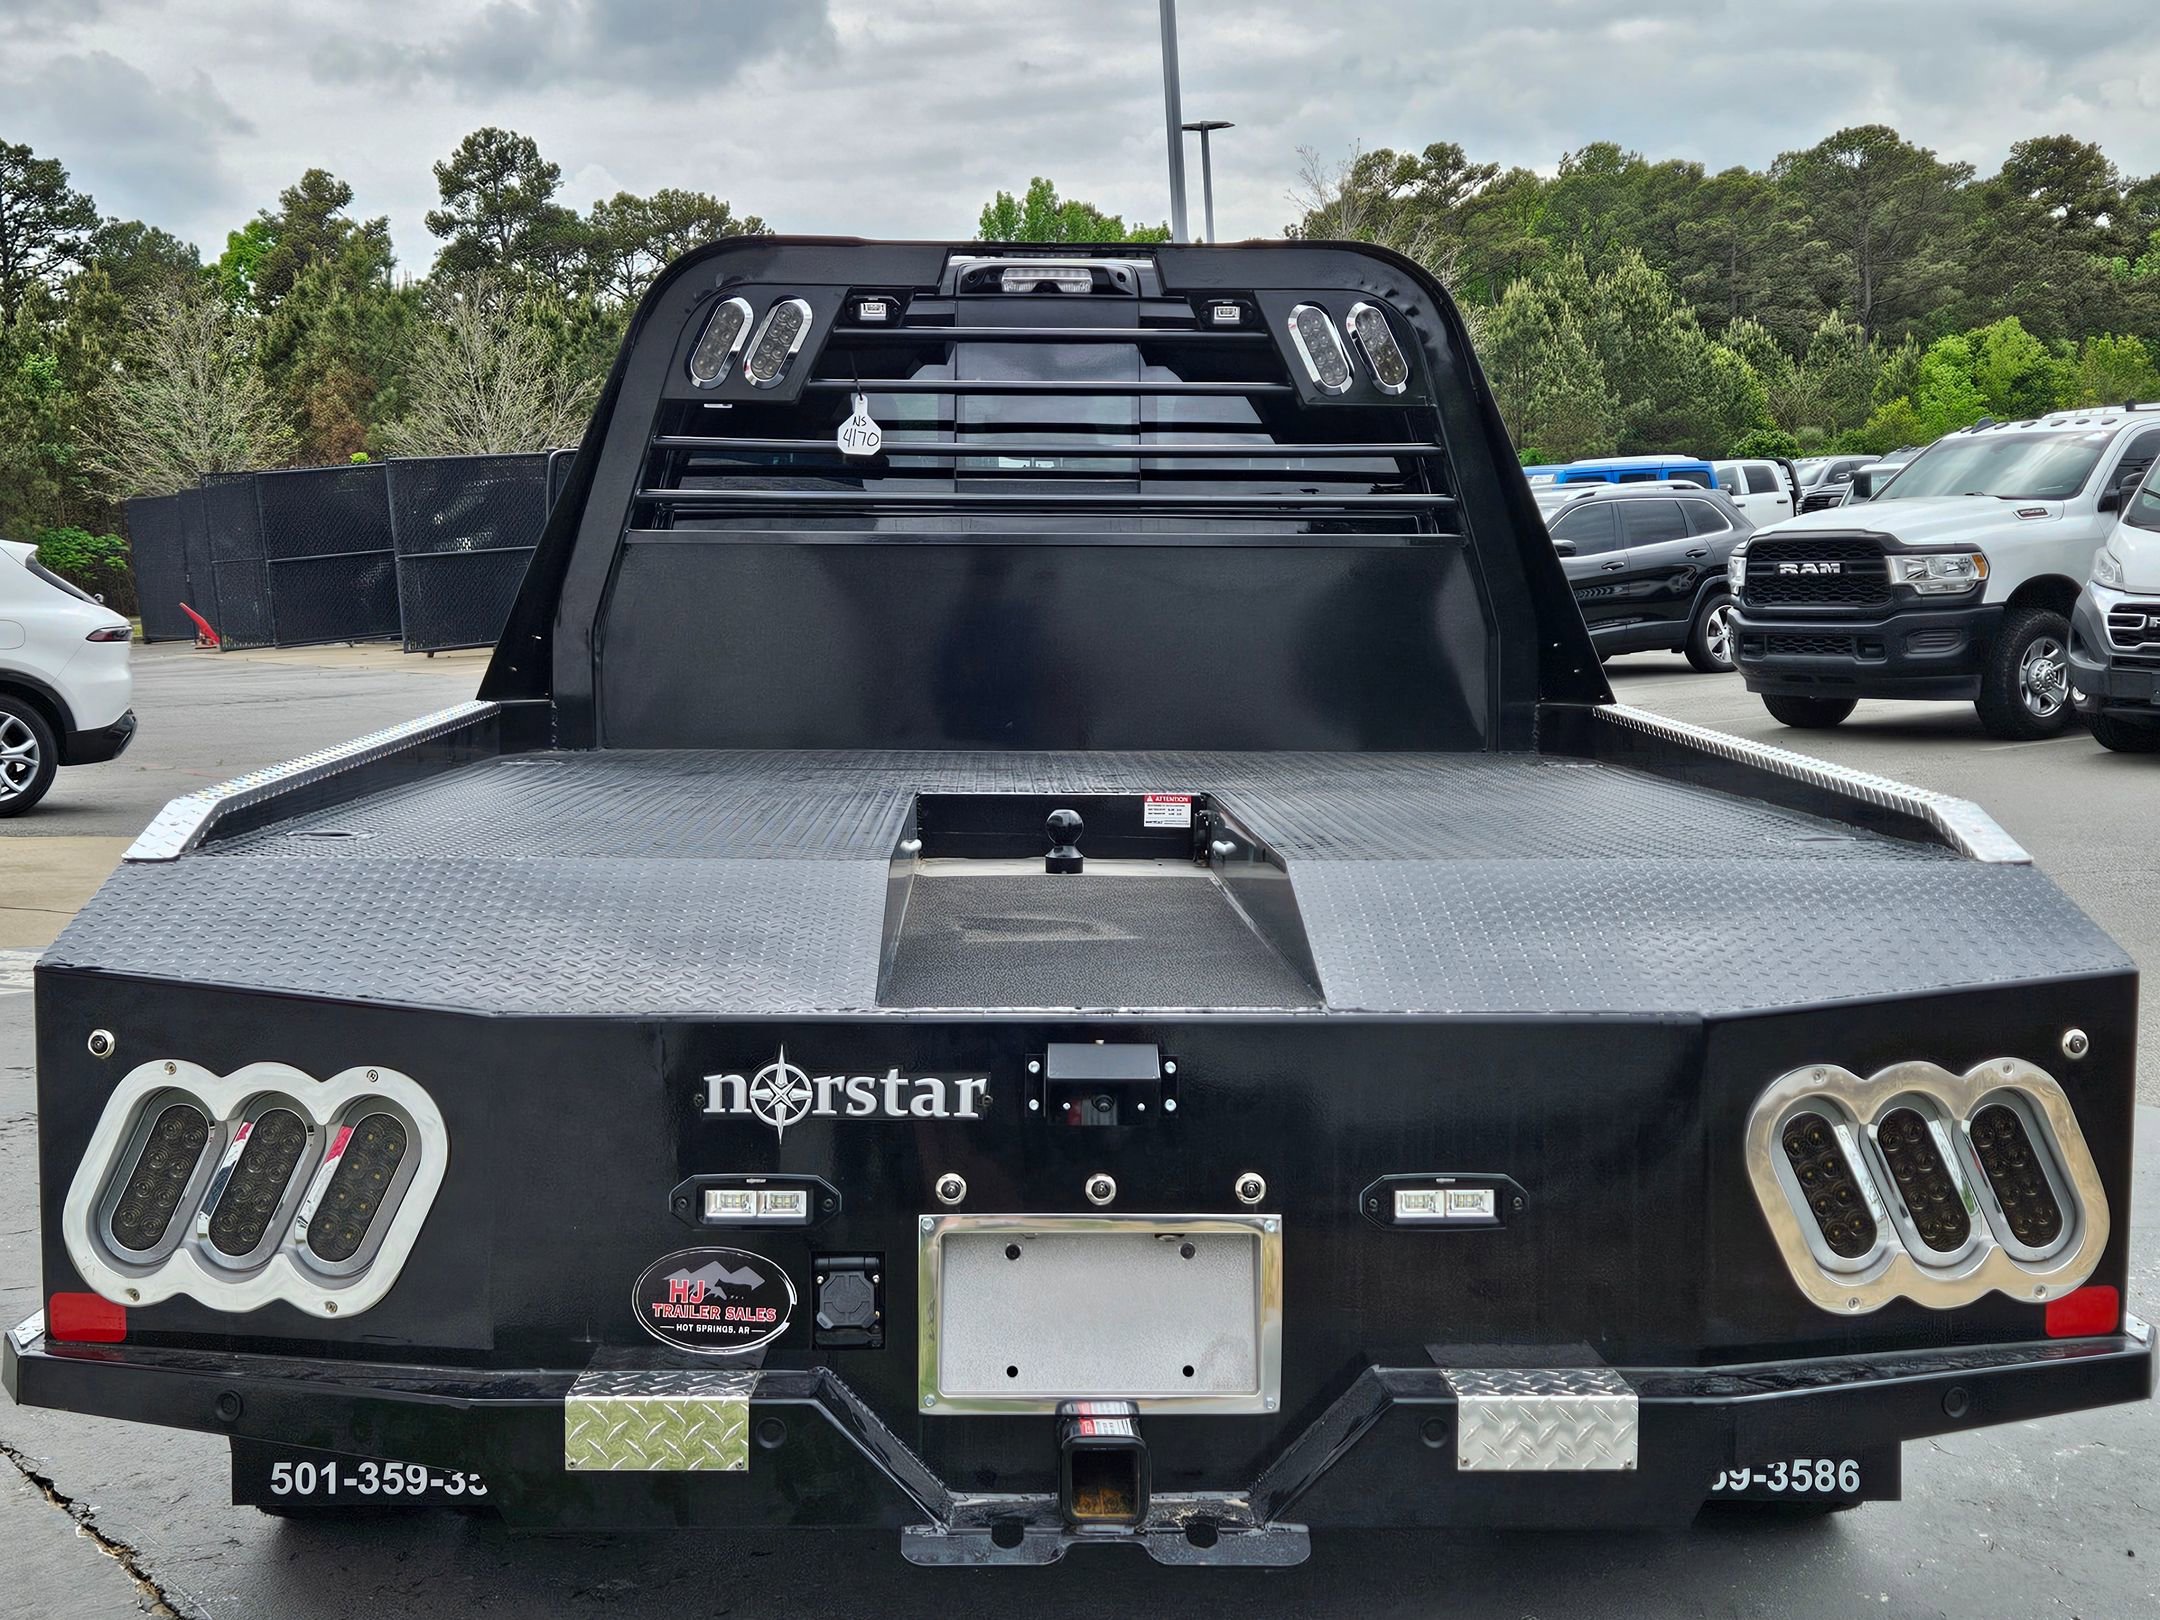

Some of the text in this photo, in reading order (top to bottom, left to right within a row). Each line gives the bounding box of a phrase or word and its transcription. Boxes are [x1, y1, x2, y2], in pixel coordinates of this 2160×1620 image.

[843, 428, 879, 447] 4170
[1779, 563, 1840, 574] RAM
[703, 1045, 988, 1144] norstar
[669, 1279, 706, 1304] HJ
[652, 1303, 777, 1322] TRAILER SALES
[676, 1323, 694, 1332] HOT
[738, 1326, 750, 1335] AR
